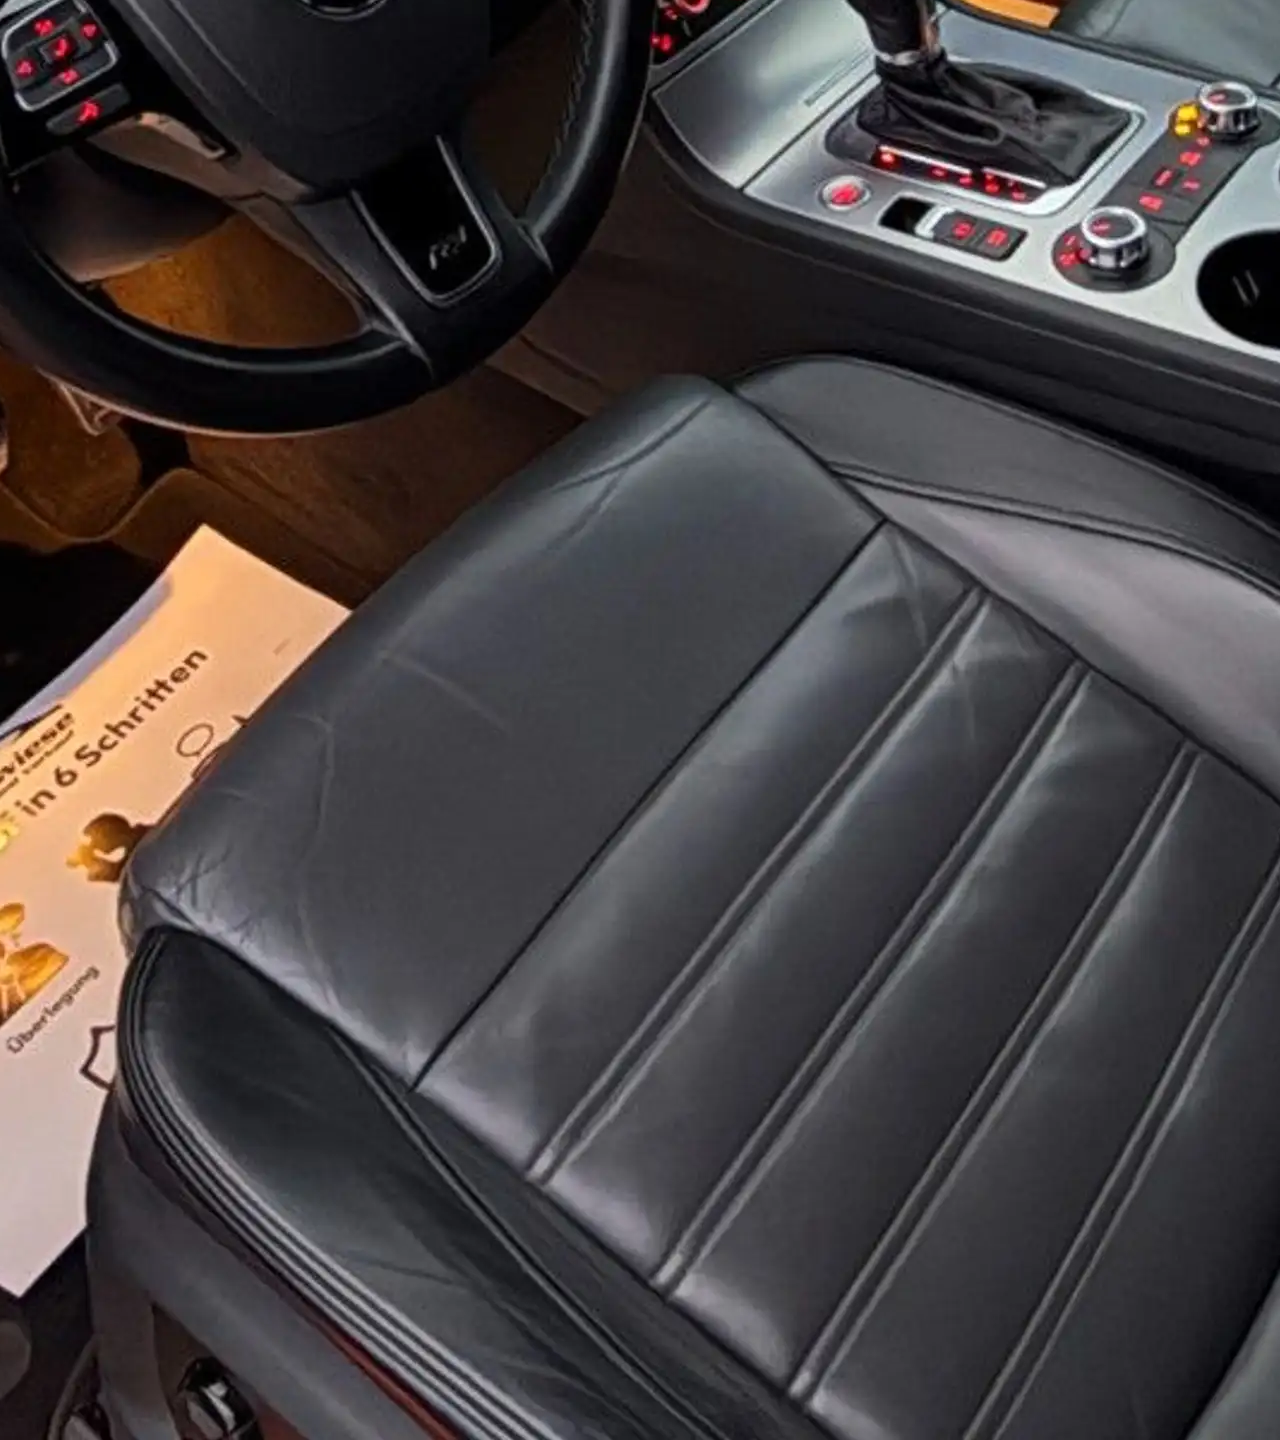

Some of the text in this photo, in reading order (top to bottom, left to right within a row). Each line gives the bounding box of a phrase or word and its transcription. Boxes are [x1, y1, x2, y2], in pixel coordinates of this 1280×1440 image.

[14, 788, 57, 818] in
[54, 765, 78, 788] 6
[73, 648, 209, 768] Schritten
[5, 964, 101, 1054] Überlegung
